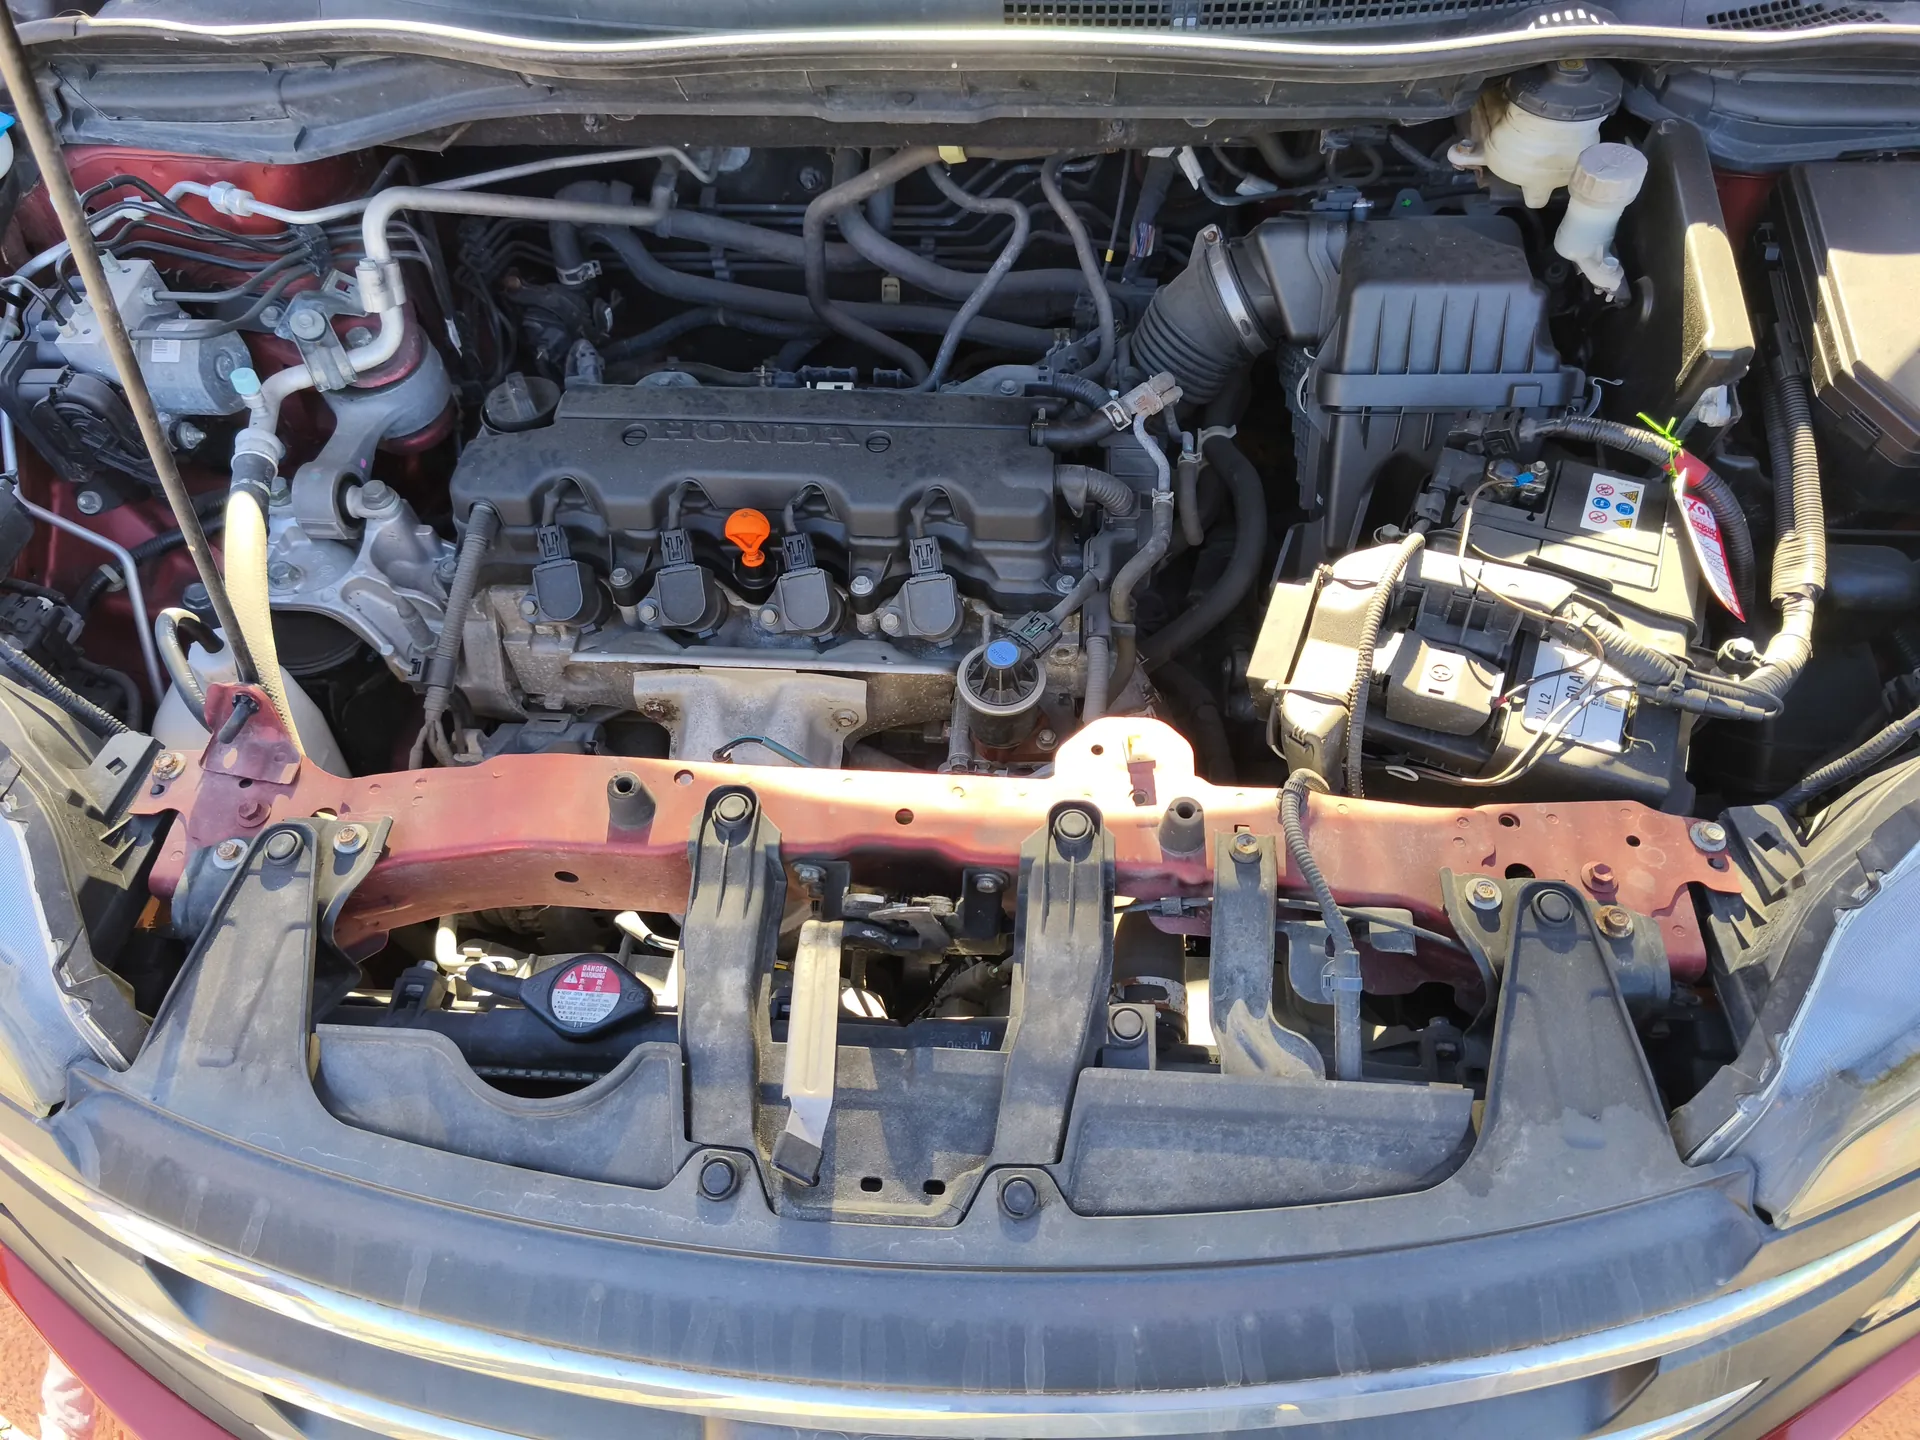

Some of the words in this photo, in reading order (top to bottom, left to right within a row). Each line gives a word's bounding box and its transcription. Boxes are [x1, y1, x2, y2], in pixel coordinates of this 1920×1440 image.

[650, 421, 861, 447] HONDA
[1539, 692, 1552, 705] L2
[582, 964, 608, 972] DANGER
